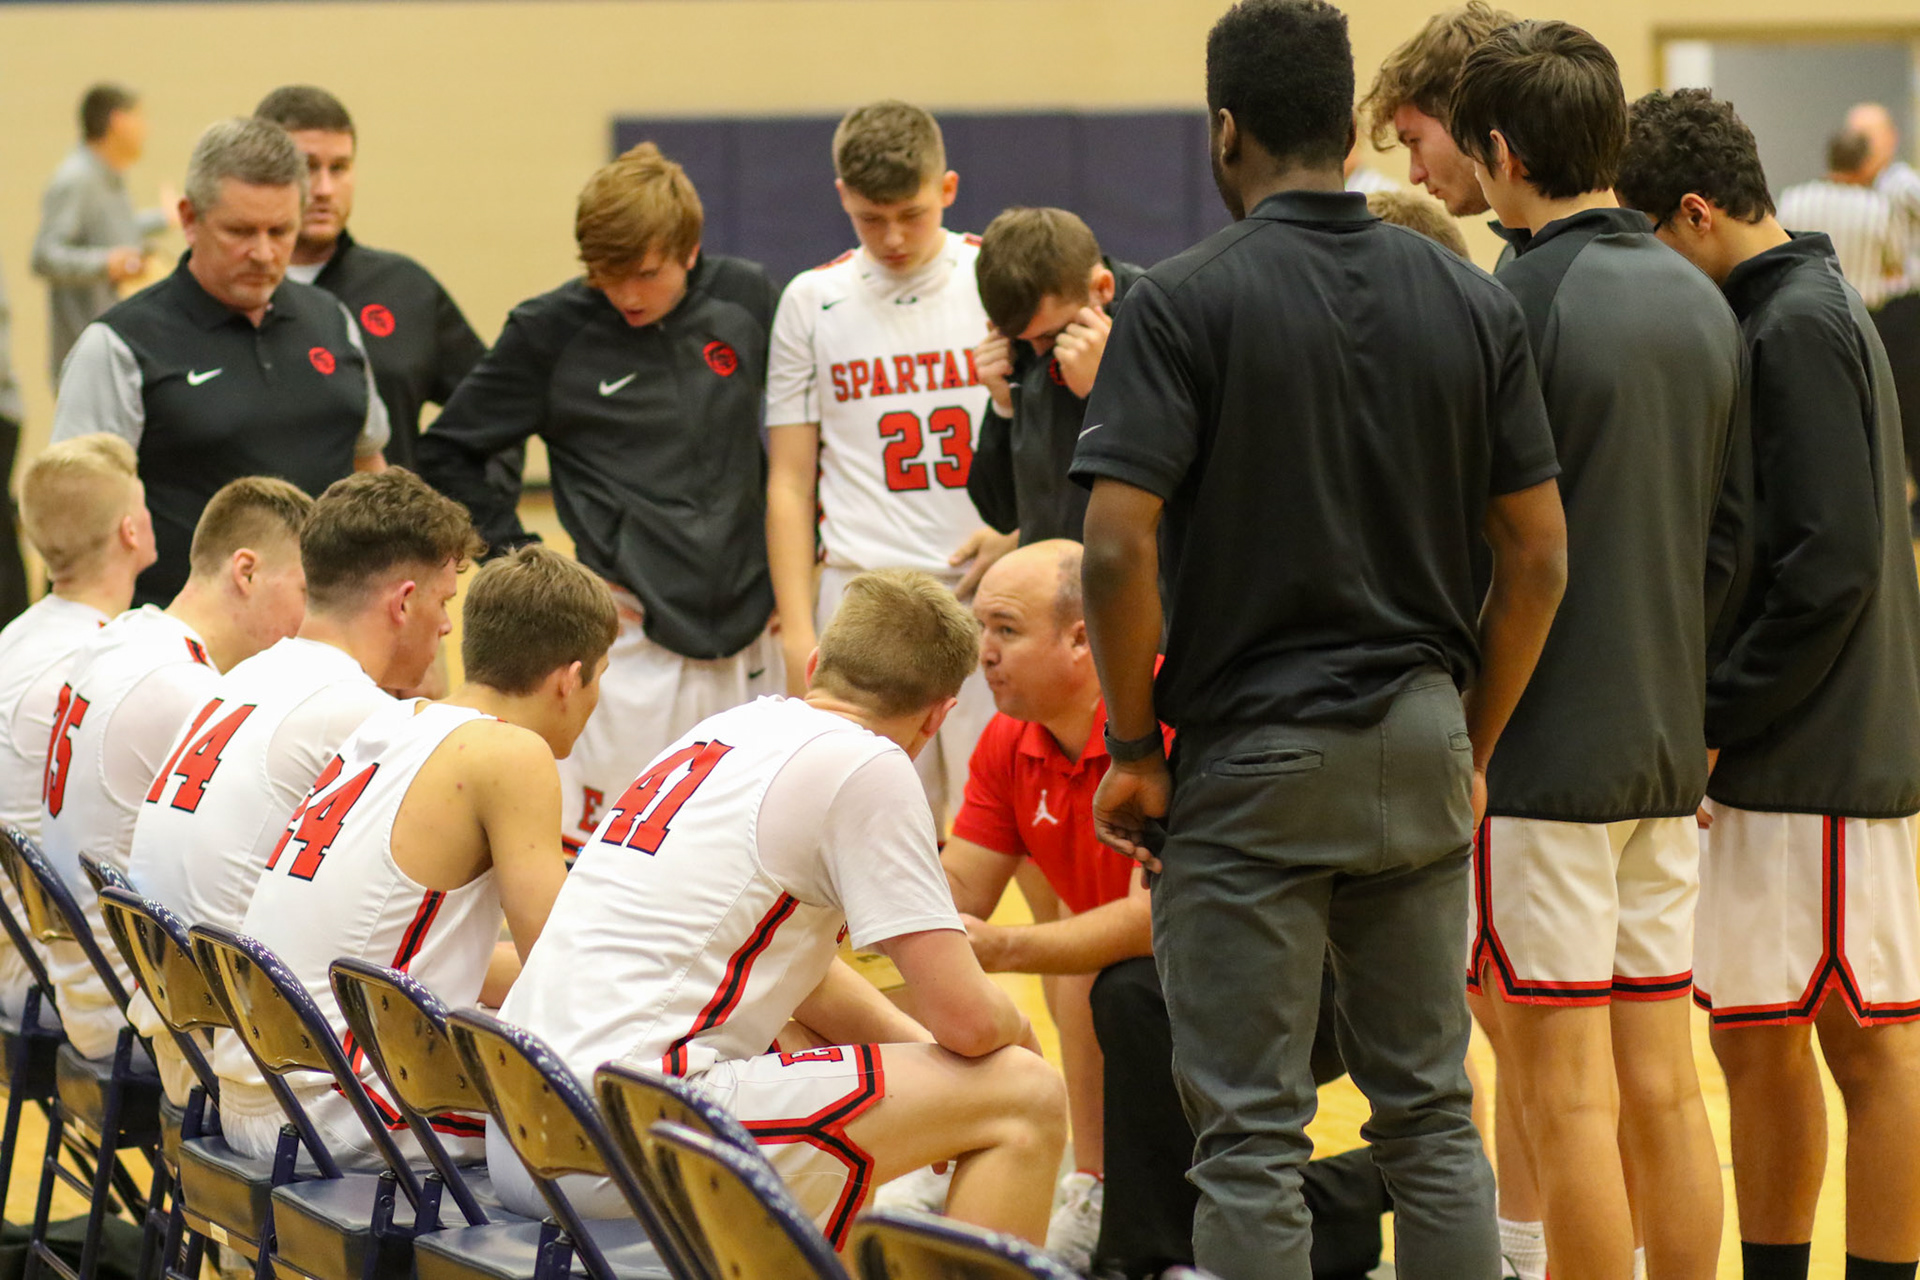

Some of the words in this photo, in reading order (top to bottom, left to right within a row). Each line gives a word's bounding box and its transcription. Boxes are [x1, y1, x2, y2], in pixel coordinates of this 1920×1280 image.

[878, 405, 973, 492] 23
[146, 697, 257, 813] 14
[600, 739, 735, 856] 41
[578, 785, 604, 834] E
